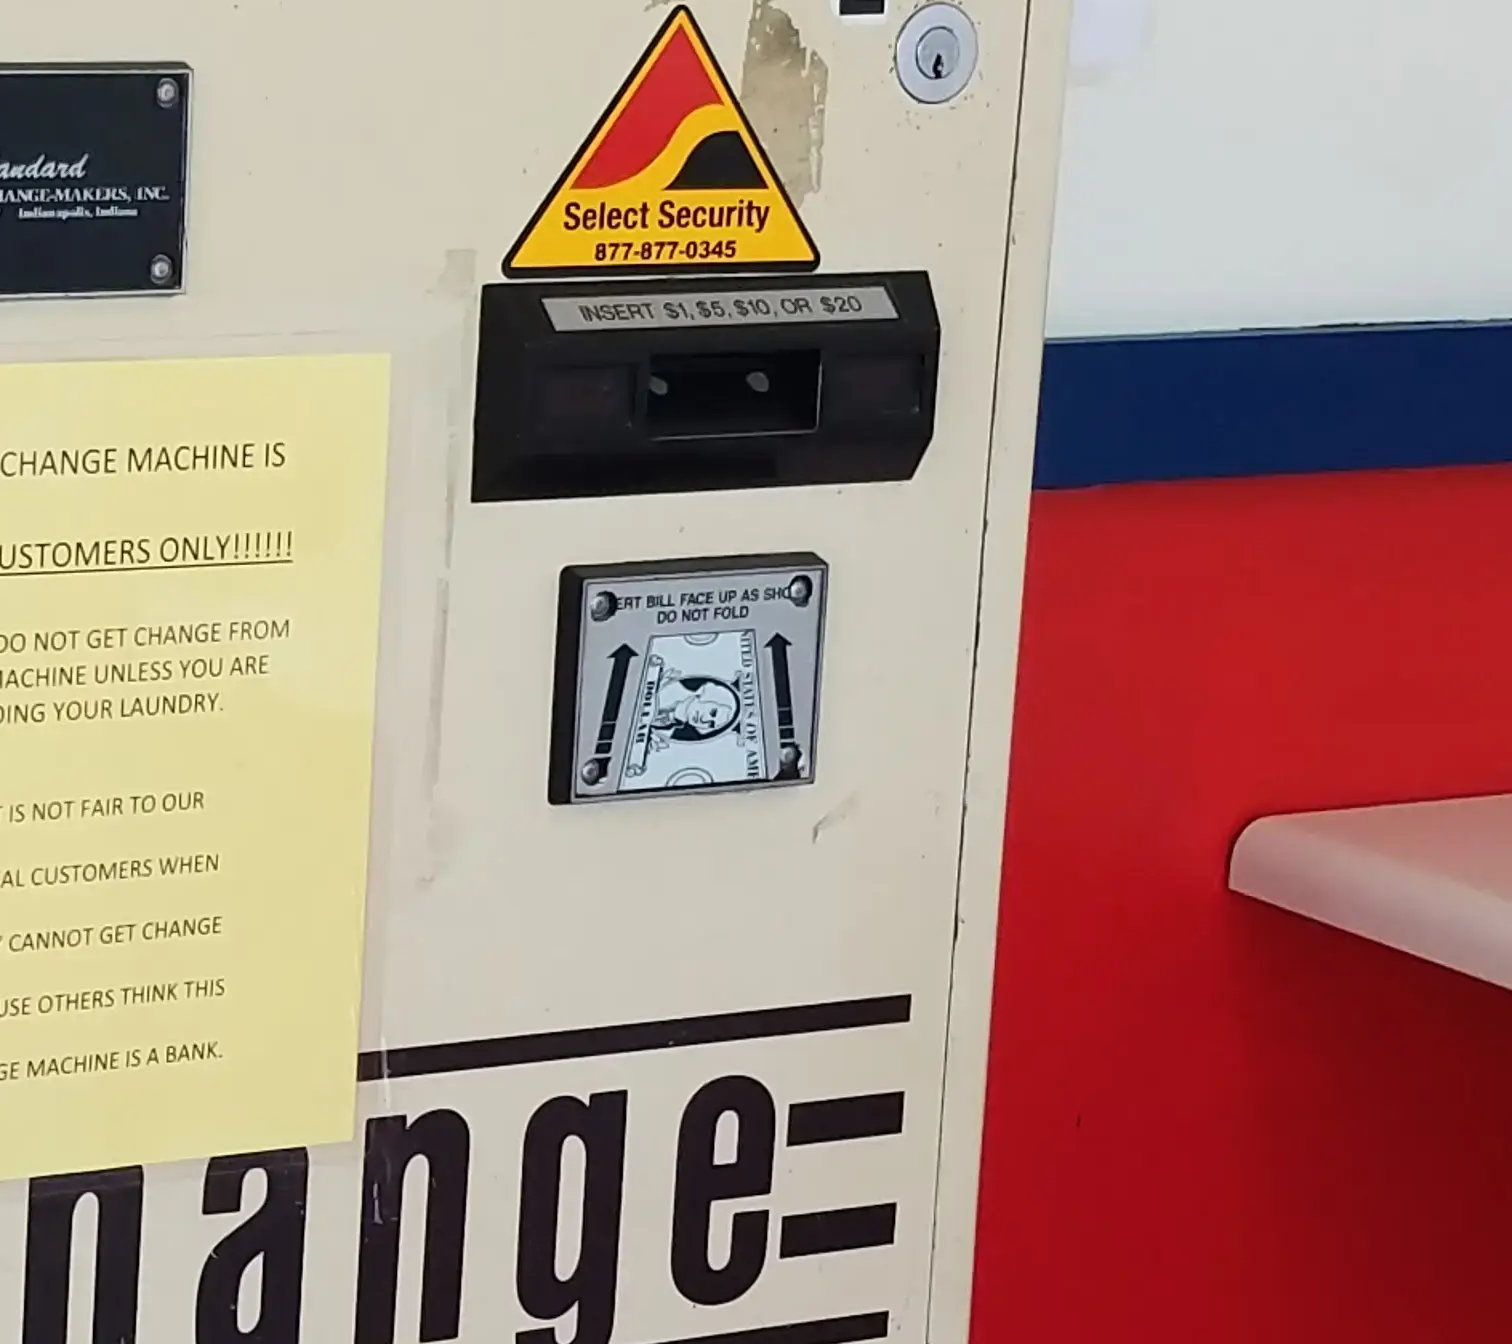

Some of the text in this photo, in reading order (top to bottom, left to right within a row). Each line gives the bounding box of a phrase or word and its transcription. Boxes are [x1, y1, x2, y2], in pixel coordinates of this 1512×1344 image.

[136, 187, 170, 201] INC.
[563, 199, 770, 233] Select Security
[594, 240, 737, 261] 877-877-0345
[578, 295, 862, 323] INSERT $1, $5, $10, OR $20
[0, 448, 117, 478] CHANGE
[127, 443, 255, 473] MACHINE
[264, 442, 286, 468] IS
[159, 531, 293, 563] ONLY!!!!!!
[646, 592, 675, 607] BILL
[680, 589, 714, 605] FACE
[718, 587, 736, 603] UP
[741, 586, 759, 601] AS
[657, 606, 749, 624] DO NOT FOLD
[34, 630, 81, 652] NOT
[86, 628, 127, 649] GET
[133, 622, 221, 646] CHANGE
[229, 619, 290, 640] FROM
[94, 661, 172, 684] UNLESS
[179, 658, 223, 679] YOU
[229, 655, 269, 676] ARE
[53, 698, 113, 722] YOUR
[120, 692, 223, 718] LAUNDRY.
[636, 680, 656, 744] DOLLAR
[8, 803, 25, 823] IS
[31, 800, 75, 821] NOT
[80, 797, 124, 818] FAIR
[129, 794, 157, 815] TO
[162, 791, 205, 812] OUR
[31, 859, 153, 887] CUSTOMERS
[159, 854, 220, 875] WHEN
[8, 927, 94, 952] CANNOT
[99, 924, 136, 945] GET
[142, 916, 223, 941] CHANGE
[37, 989, 115, 1014] OTHERS
[120, 983, 178, 1007] THINK
[184, 978, 226, 998] THIS
[26, 1052, 119, 1078] MACHINE
[125, 1049, 141, 1068] IS
[146, 1047, 160, 1066] A
[166, 1040, 223, 1063] BANK.
